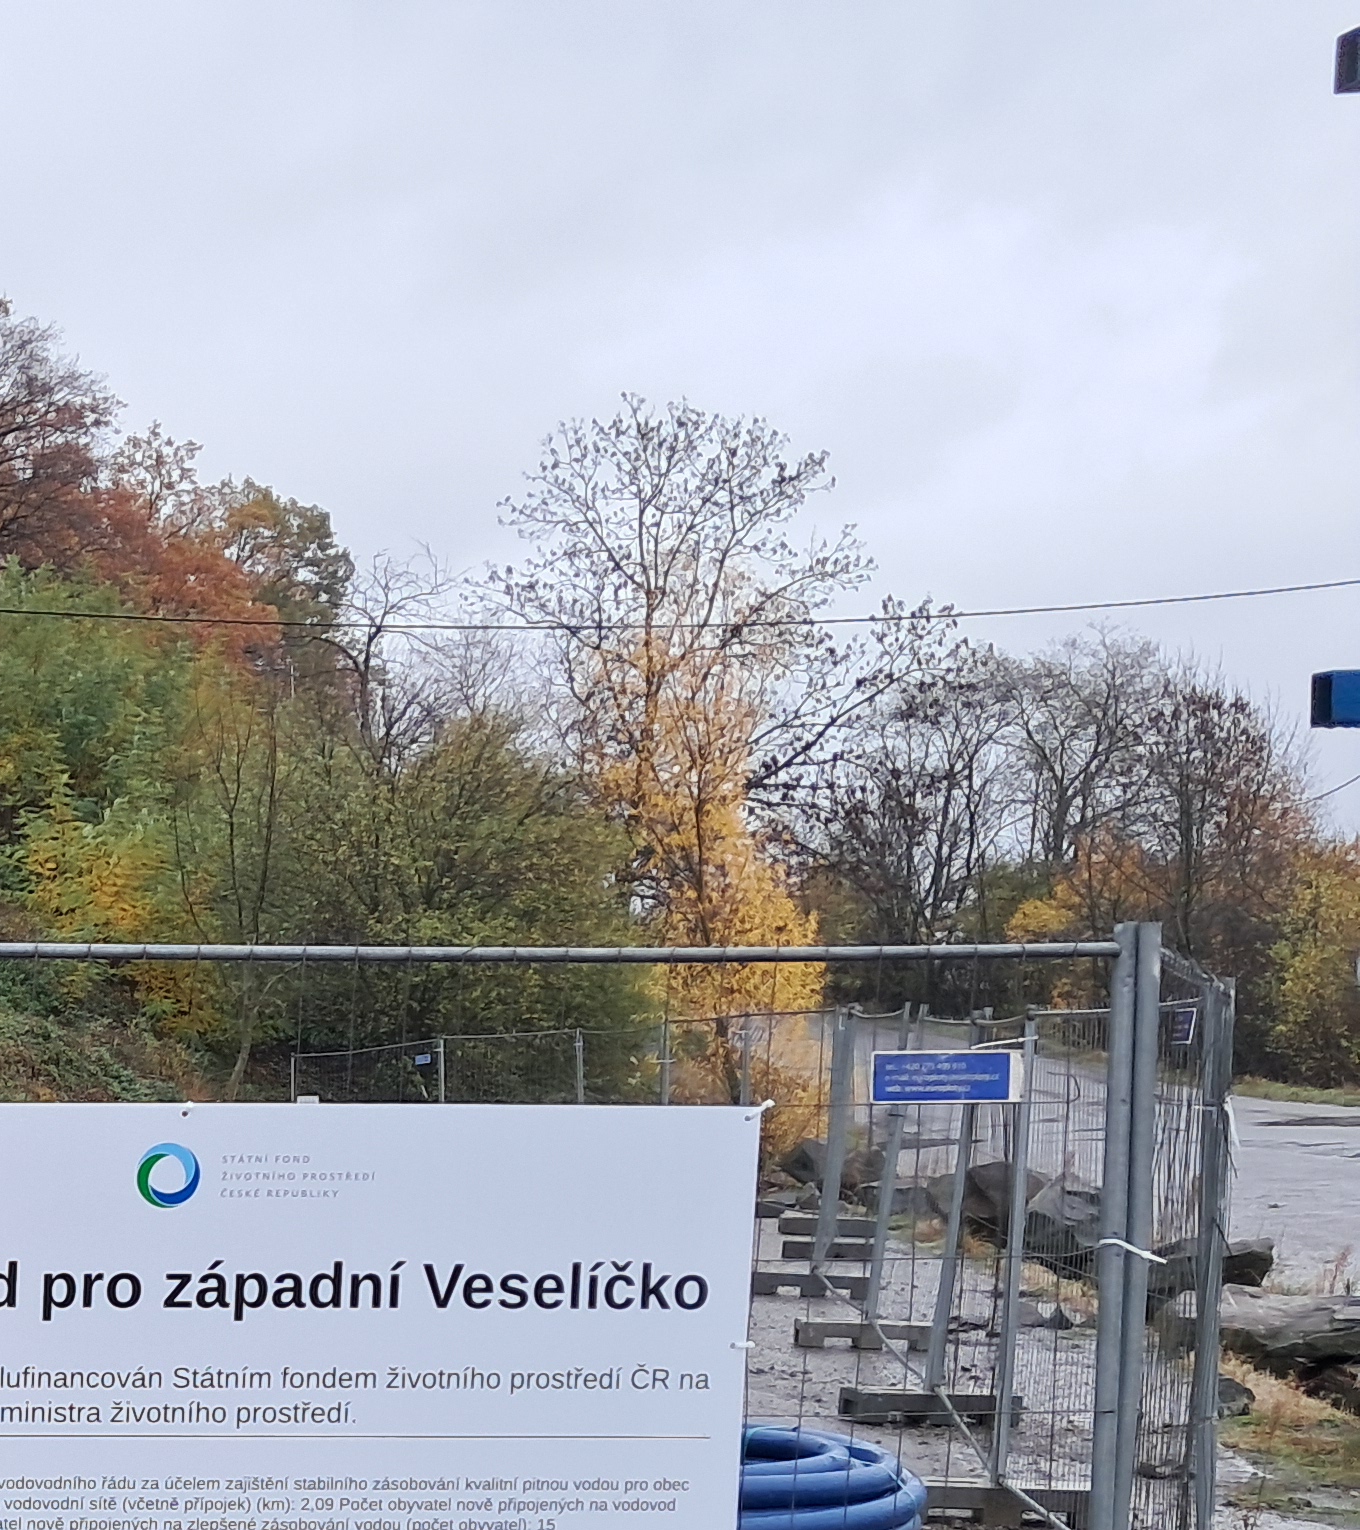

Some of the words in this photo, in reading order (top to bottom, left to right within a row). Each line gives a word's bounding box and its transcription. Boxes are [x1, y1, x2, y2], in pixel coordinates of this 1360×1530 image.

[222, 1154, 267, 1164] STÁTNÍ
[275, 1155, 310, 1163] FOND
[222, 1171, 295, 1181] ŽIVOTNÍHO
[303, 1172, 375, 1181] PROSTŘEDÍ
[220, 1188, 259, 1198] ČESKÉ
[267, 1189, 339, 1198] REPUBLIKY
[42, 1273, 141, 1321] pro
[163, 1260, 406, 1321] západní
[424, 1261, 708, 1310] Veselíčko
[173, 1366, 271, 1388] Státním
[281, 1367, 376, 1388] fondem
[386, 1367, 500, 1389] životního
[511, 1367, 622, 1394] prostředí
[631, 1364, 669, 1389] ČR
[680, 1374, 709, 1389] na
[1, 1401, 102, 1423] ministra
[110, 1401, 226, 1423] životního
[237, 1402, 355, 1429] prostředí.
[102, 1476, 136, 1489] řádu
[141, 1480, 159, 1489] za
[165, 1476, 220, 1490] účelem
[225, 1477, 288, 1493] zajištění
[294, 1477, 367, 1490] stabilního
[372, 1477, 460, 1490] zásobování
[465, 1477, 518, 1490] kvalitní
[523, 1479, 568, 1494] pitnou
[573, 1478, 619, 1490] vodou
[624, 1481, 648, 1494] pro
[653, 1478, 689, 1491] obec
[4, 1497, 84, 1510] vodovodní
[89, 1496, 116, 1510] sítě
[123, 1497, 179, 1513] (včetně
[184, 1497, 251, 1514] přípojek)
[257, 1497, 294, 1514] (km):
[301, 1498, 333, 1512] 2,09
[340, 1498, 382, 1511] Počet
[388, 1498, 451, 1514] obyvatel
[457, 1498, 493, 1511] nově
[498, 1498, 584, 1514] připojených
[590, 1501, 608, 1511] na
[612, 1498, 676, 1511] vodovod
[27, 1517, 64, 1530] nově
[164, 1521, 182, 1530] na
[261, 1518, 349, 1530] zásobování
[355, 1518, 400, 1530] vodou
[538, 1519, 555, 1530] 15
